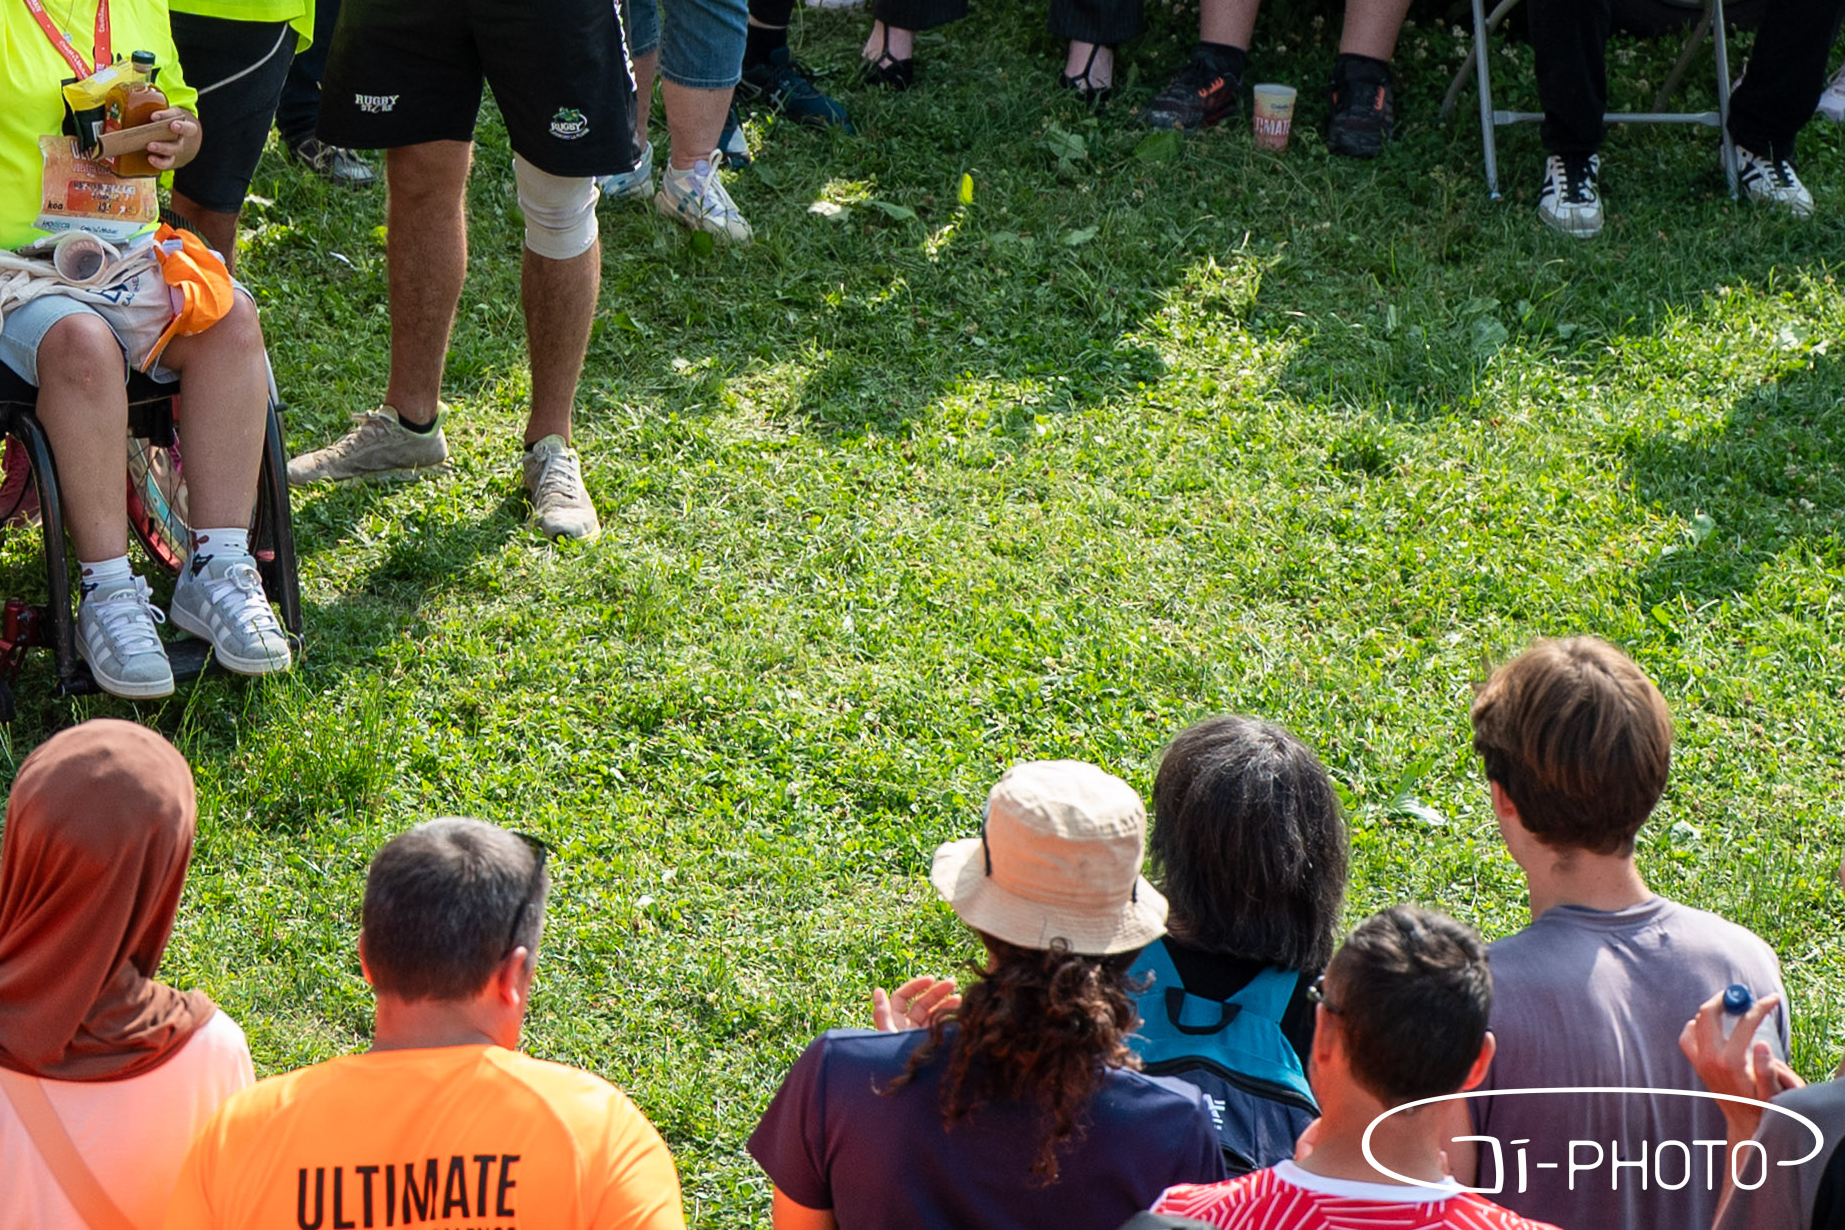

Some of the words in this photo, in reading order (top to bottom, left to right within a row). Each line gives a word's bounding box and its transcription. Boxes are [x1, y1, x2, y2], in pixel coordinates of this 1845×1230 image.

[355, 94, 400, 106] RUGBY
[551, 121, 583, 131] RUGBY
[297, 1154, 521, 1230] ULTIMATE
